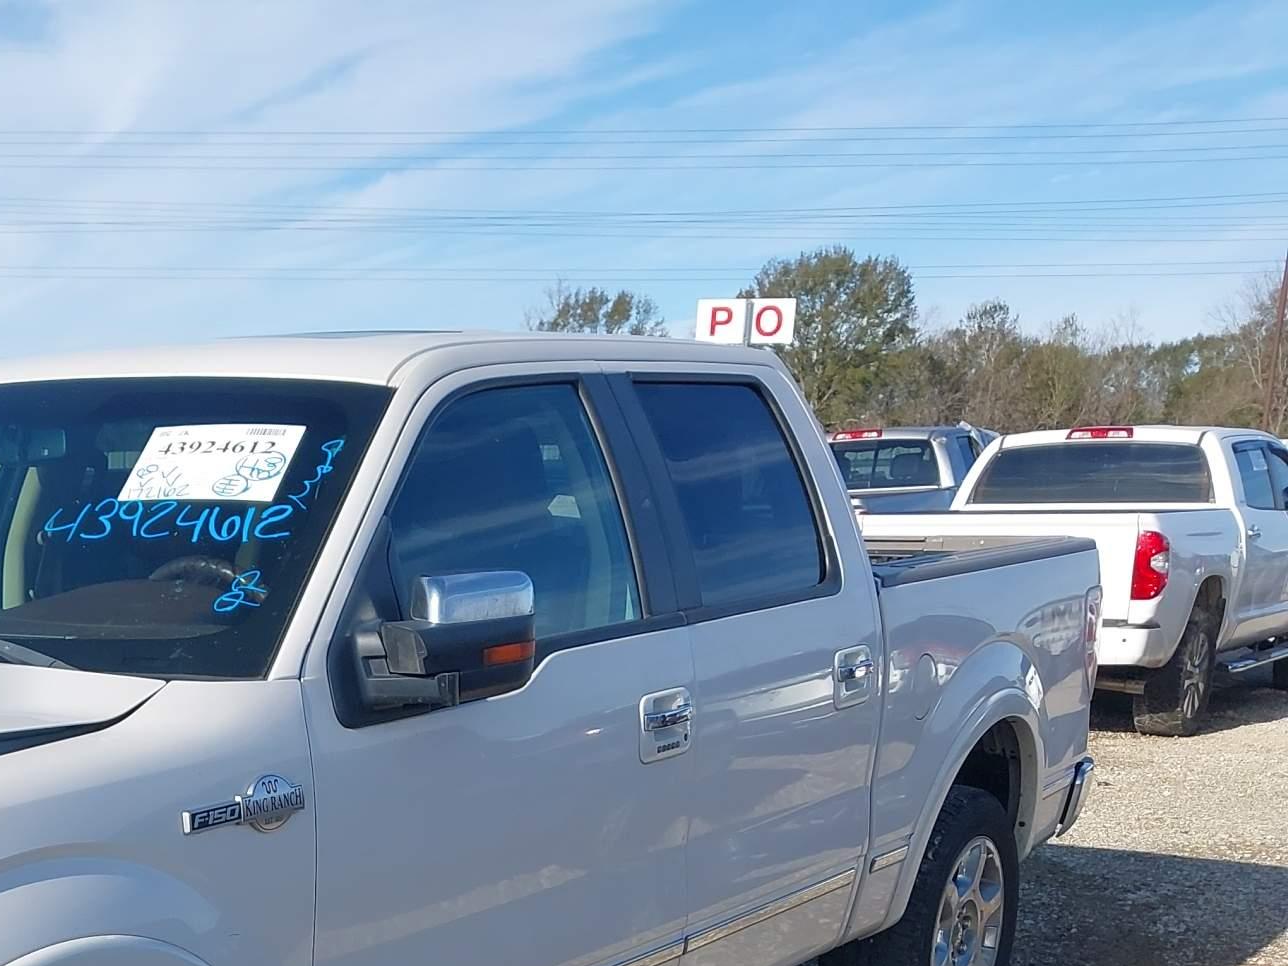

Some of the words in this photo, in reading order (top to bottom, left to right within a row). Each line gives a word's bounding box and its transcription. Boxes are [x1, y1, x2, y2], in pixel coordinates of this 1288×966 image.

[709, 306, 733, 337] P
[755, 305, 783, 337] O
[158, 440, 276, 456] 43924612
[44, 497, 293, 543] 43924612
[194, 805, 240, 828] F-150
[244, 798, 270, 817] KING
[271, 788, 302, 811] RANCH
